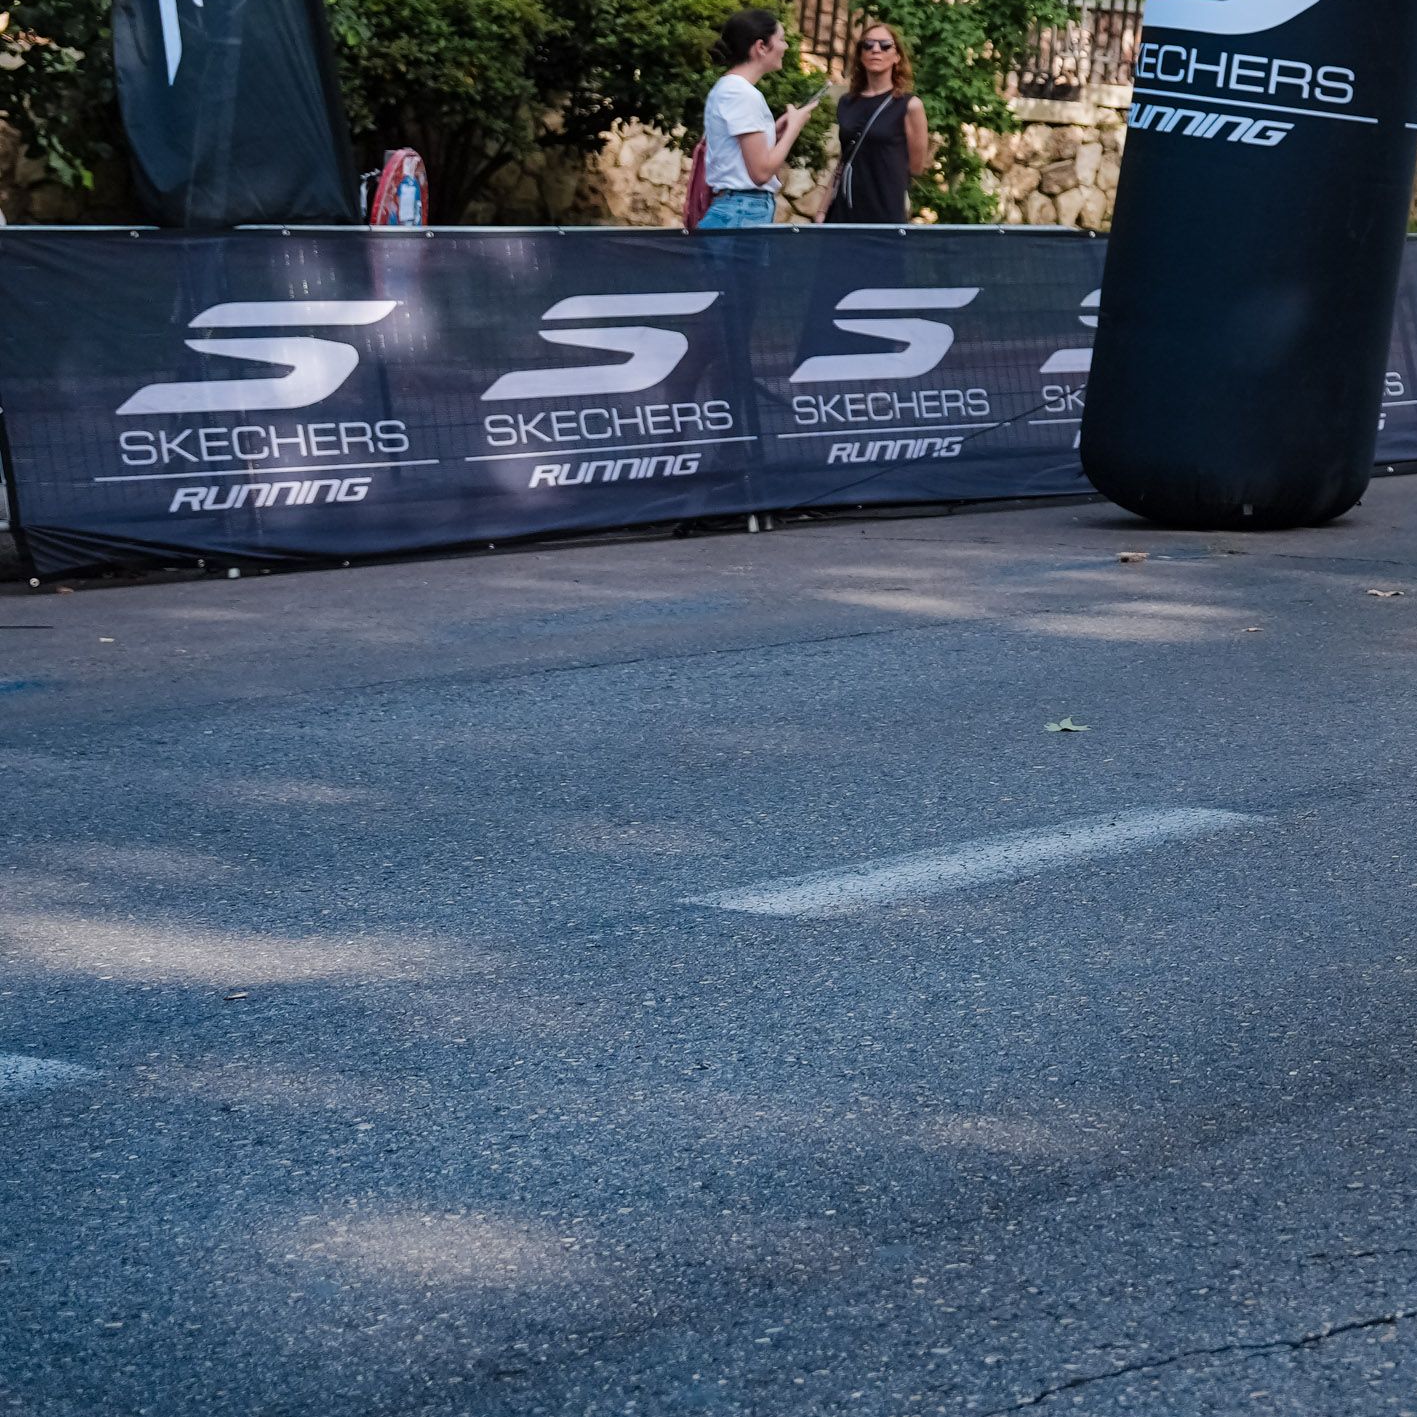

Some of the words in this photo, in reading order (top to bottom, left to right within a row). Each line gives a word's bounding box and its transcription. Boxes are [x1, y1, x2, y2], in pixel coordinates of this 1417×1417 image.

[1136, 42, 1356, 104] ECHERS
[484, 400, 734, 447] SKECHERS
[792, 387, 991, 426] SKECHERS
[119, 419, 410, 466] SKECHERS
[827, 436, 965, 465] RUNNING
[528, 452, 702, 489] RUNNING
[169, 476, 373, 514] RUNNING
